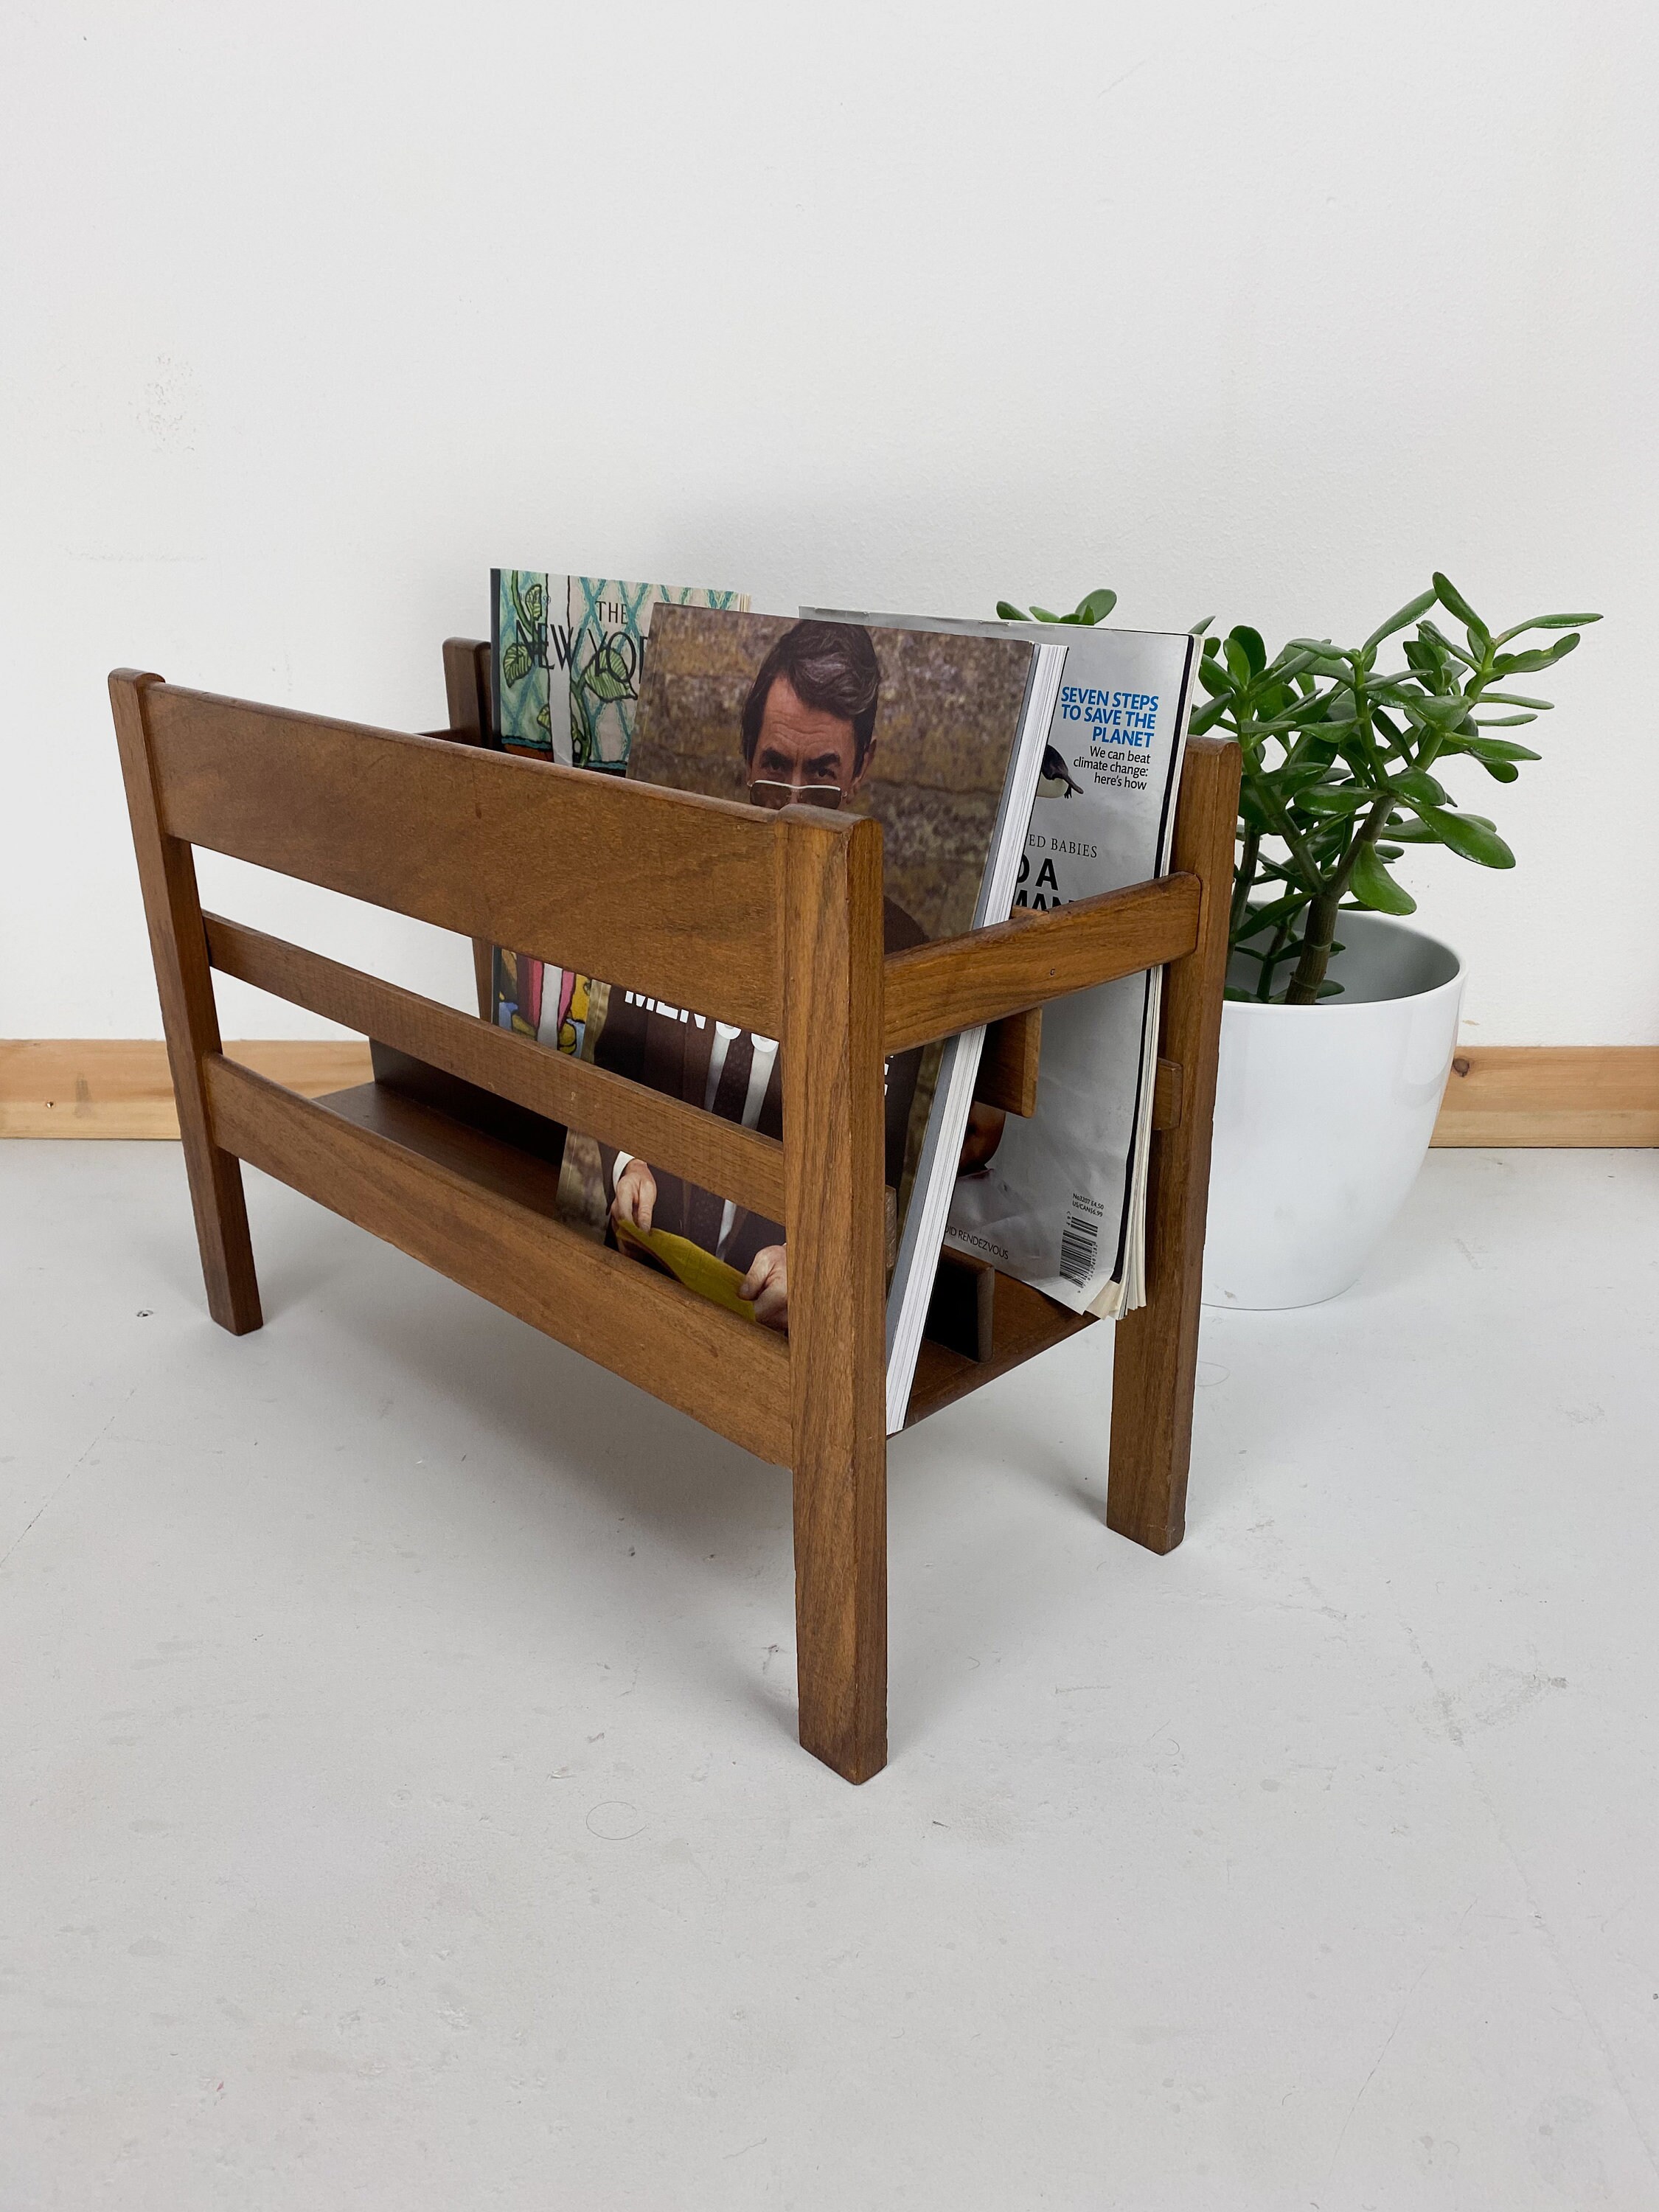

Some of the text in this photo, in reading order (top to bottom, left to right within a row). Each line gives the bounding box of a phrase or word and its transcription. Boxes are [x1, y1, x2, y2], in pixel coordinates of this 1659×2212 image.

[595, 601, 627, 625] THE
[516, 619, 582, 671] NEW
[1061, 686, 1159, 712] SEVEN STEPS
[1062, 704, 1156, 729] TO SAVE THE
[1092, 726, 1154, 748] PLANET
[1090, 745, 1151, 764] We can beat
[1074, 757, 1149, 779] climate change:
[1094, 772, 1147, 790] here's how
[1051, 838, 1097, 858] BABIES
[958, 1229, 1009, 1260] RENDEZVOUS
